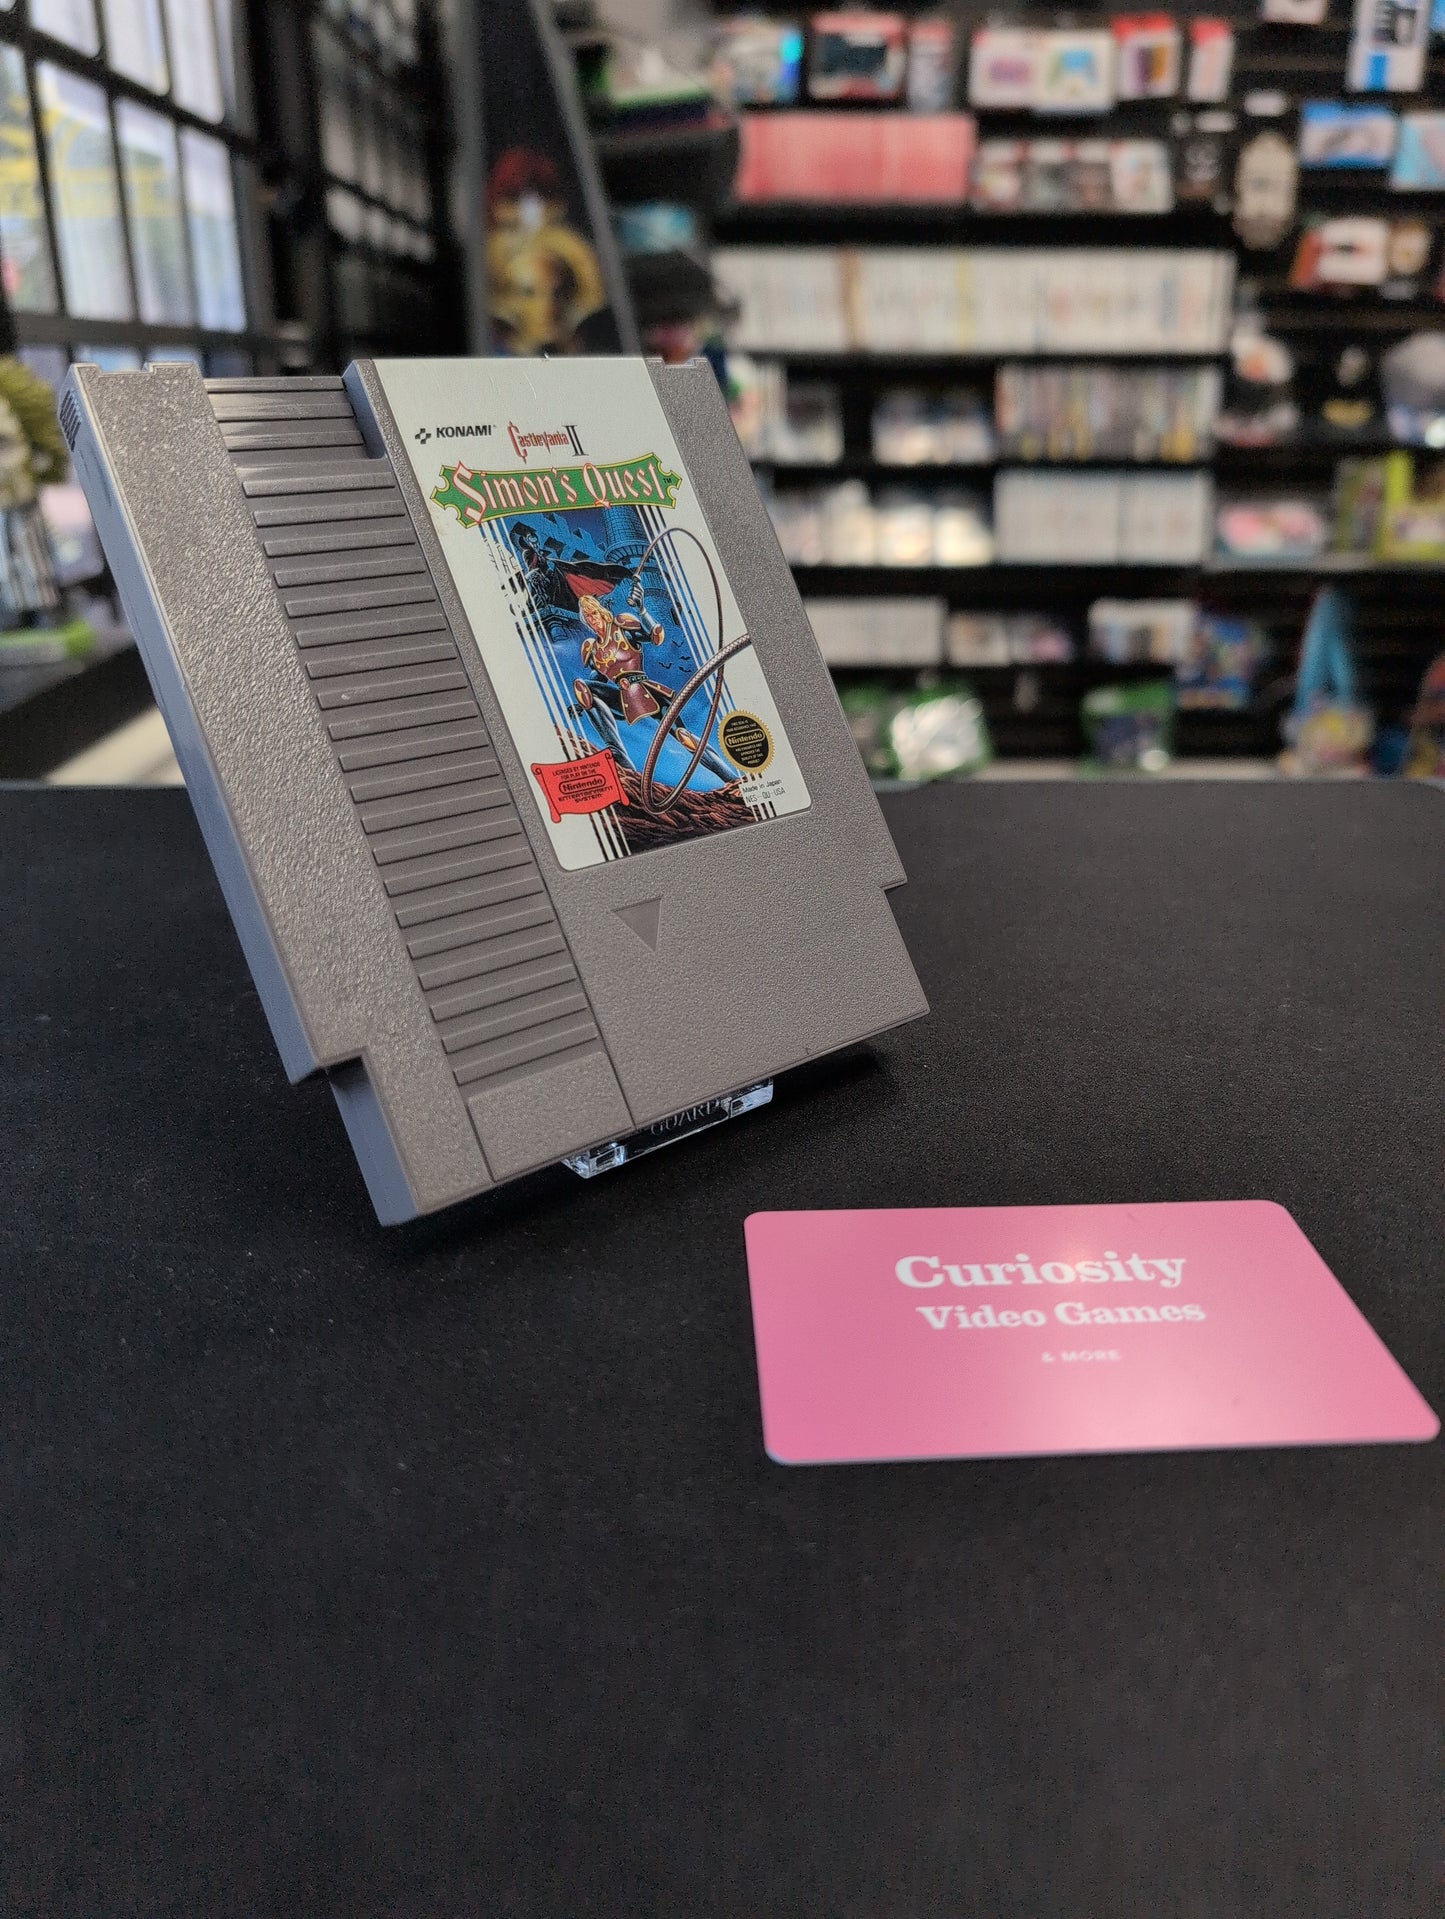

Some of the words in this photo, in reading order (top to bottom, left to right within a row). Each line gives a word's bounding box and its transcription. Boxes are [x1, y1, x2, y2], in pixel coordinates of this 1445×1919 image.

[436, 424, 492, 438] KONAMI
[507, 420, 570, 464] Castlevania
[562, 424, 590, 457] II
[452, 460, 578, 525] Simon's
[582, 462, 665, 509] Quest
[728, 731, 763, 745] Nintendo
[562, 778, 603, 792] Nintendo
[895, 1251, 1187, 1288] Curiosity
[916, 1305, 1047, 1329] Video
[1054, 1302, 1206, 1326] Games
[1041, 1351, 1056, 1363] &
[1061, 1349, 1121, 1362] MORE
